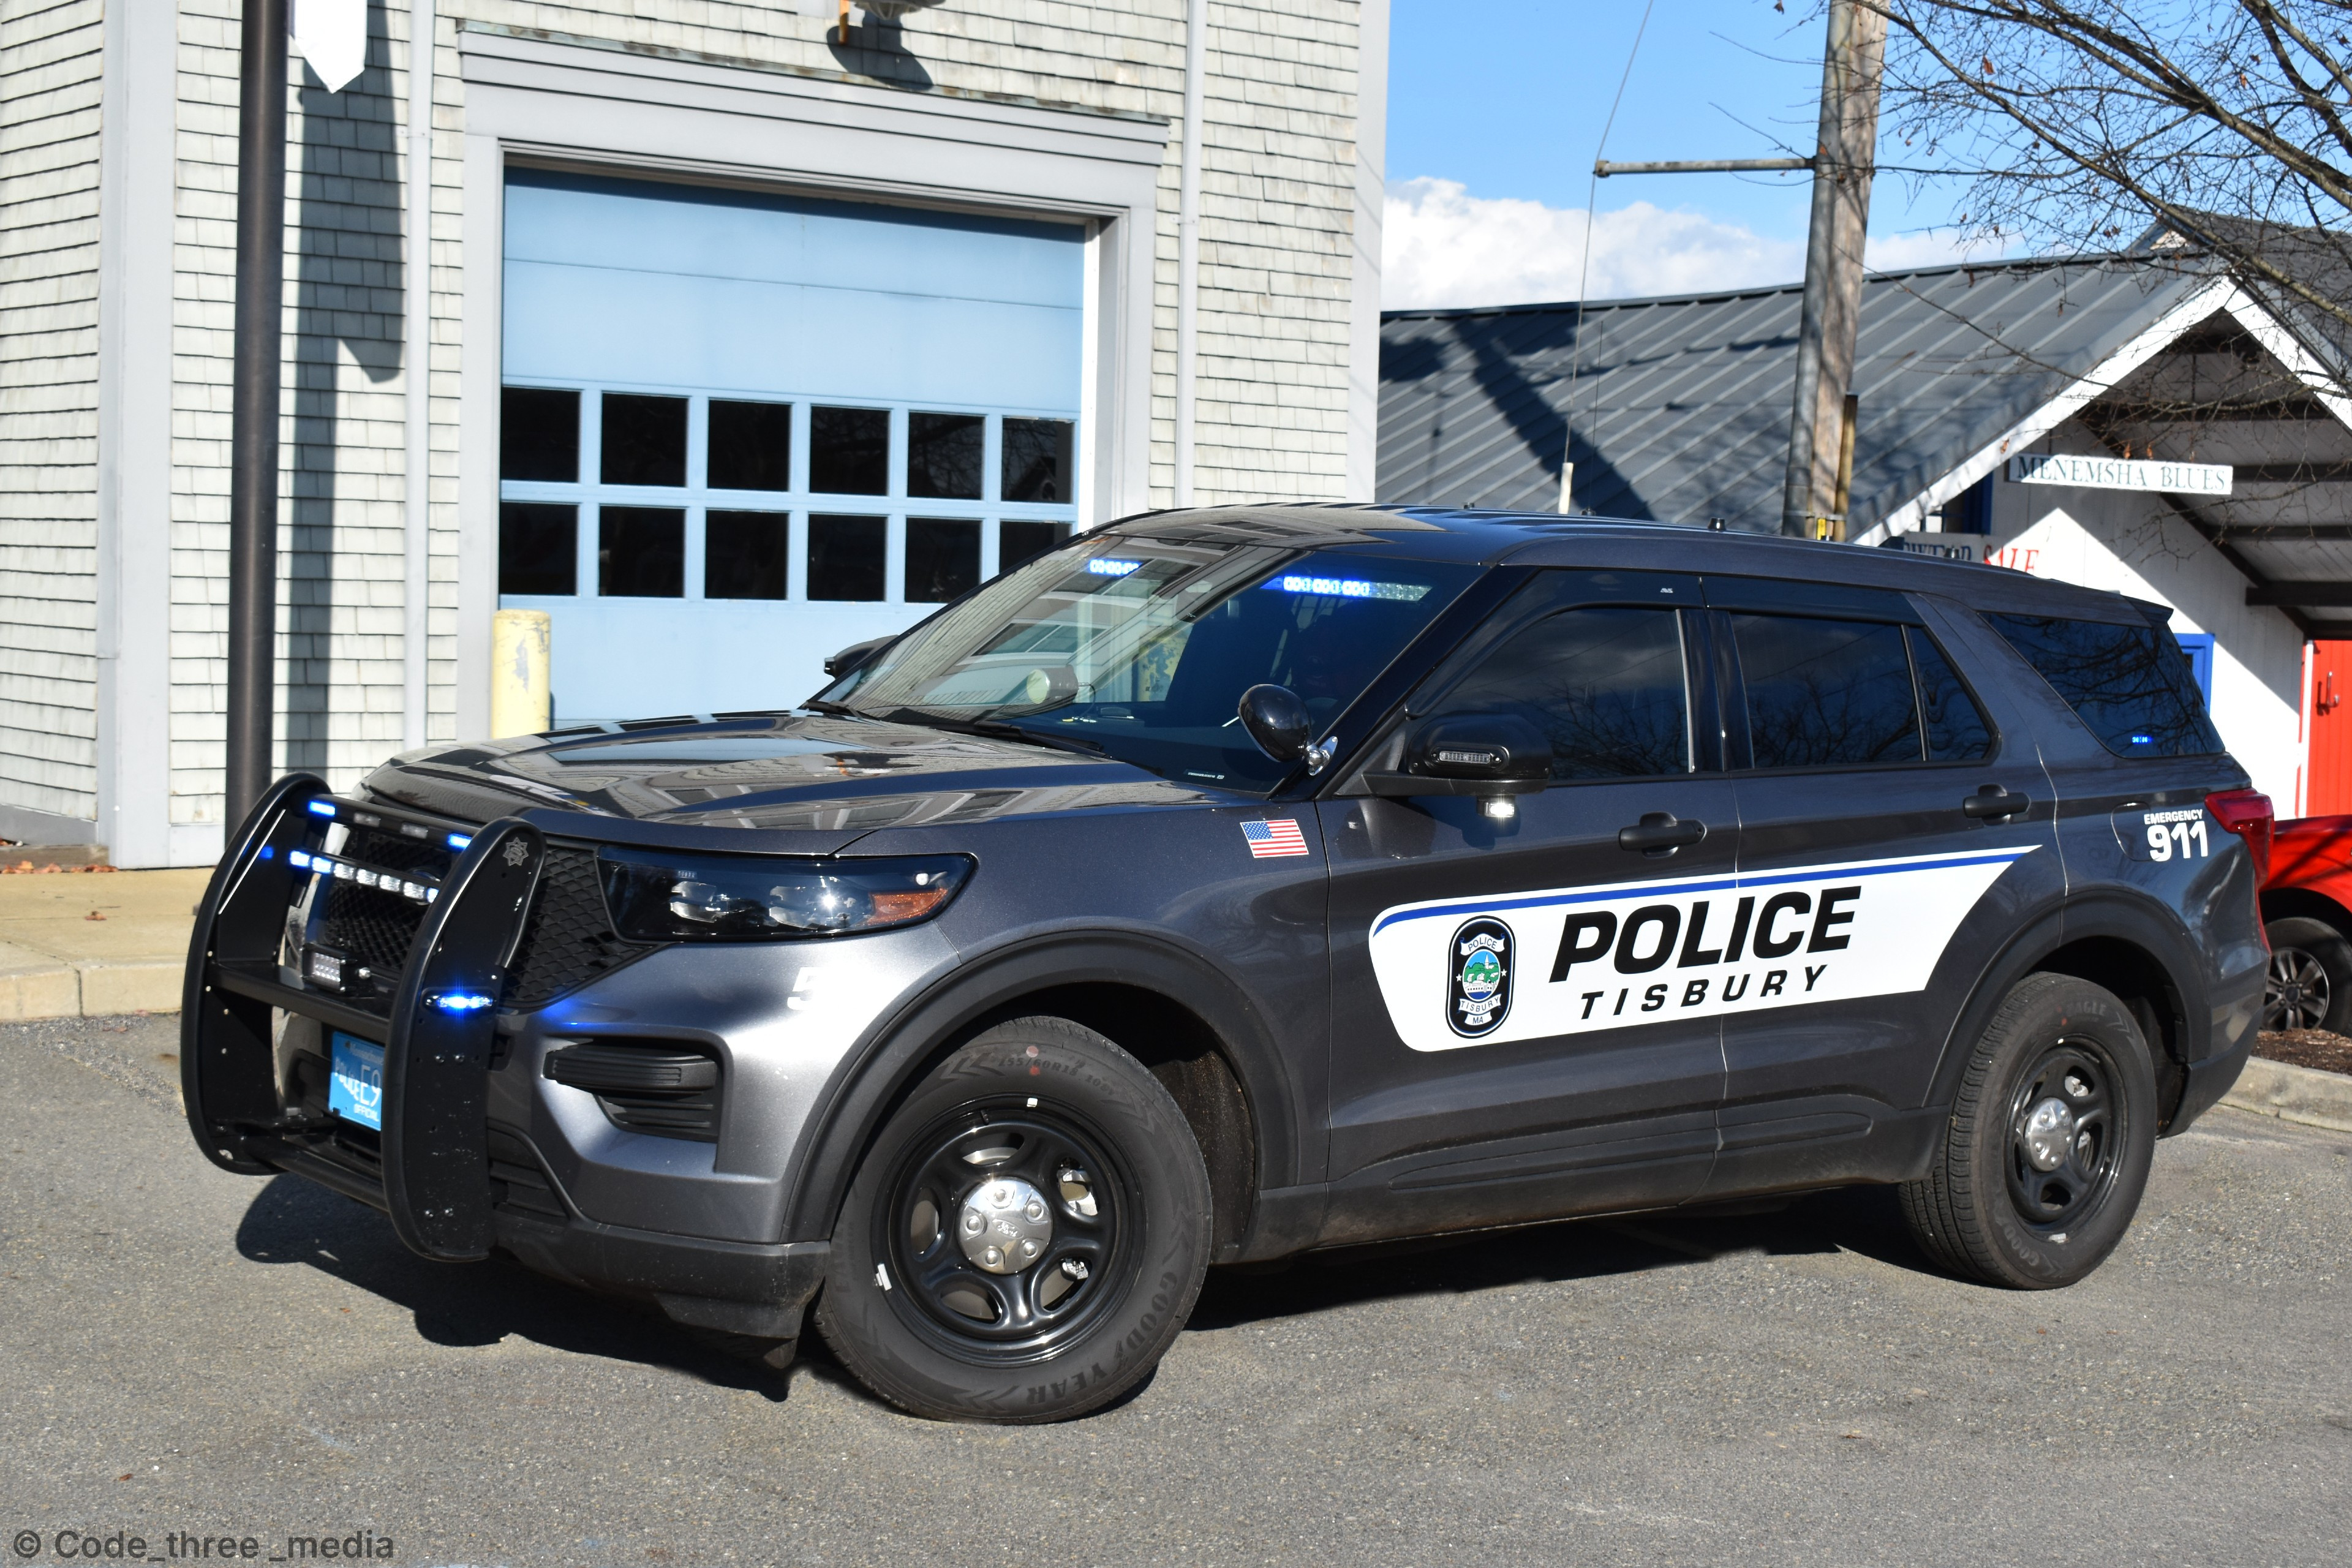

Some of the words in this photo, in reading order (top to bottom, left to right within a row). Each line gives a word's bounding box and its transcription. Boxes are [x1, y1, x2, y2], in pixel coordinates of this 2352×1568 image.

[2018, 456, 2147, 486] MENEMSHA
[2161, 466, 2225, 490] BLUES
[1983, 545, 2039, 572] SALE
[2144, 809, 2203, 824] EMERGENCY
[2147, 821, 2208, 862] 911
[1468, 937, 1498, 952] POLICE
[1548, 885, 1861, 983] POLICE
[1461, 997, 1500, 1012] TISBURY
[1580, 964, 1828, 1020] TISBURY
[1472, 1016, 1484, 1025] MA
